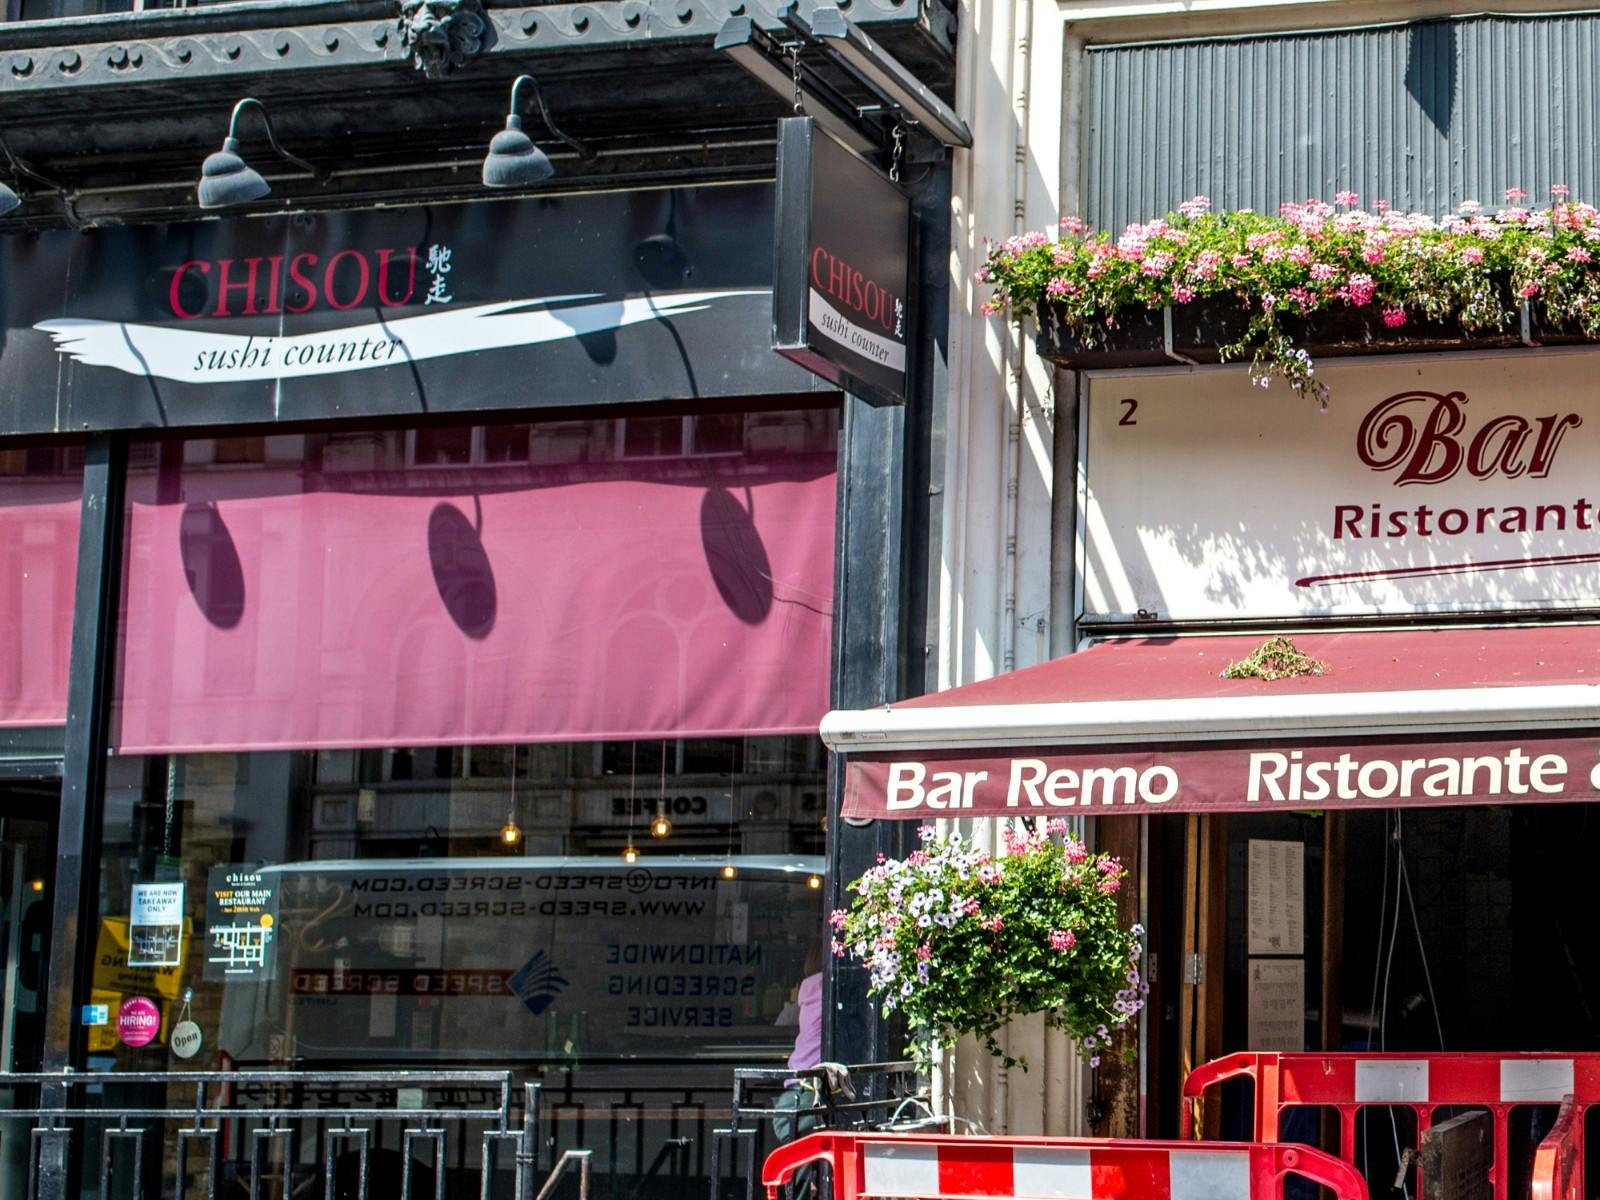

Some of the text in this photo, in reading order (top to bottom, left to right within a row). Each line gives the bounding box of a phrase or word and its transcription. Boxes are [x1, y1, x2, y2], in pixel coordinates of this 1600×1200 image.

[169, 247, 417, 320] CHISOU
[812, 247, 893, 330] CHISOU
[193, 336, 403, 371] sushi counter
[822, 311, 890, 362] sushi counter
[1118, 398, 1138, 426] 2
[1356, 390, 1583, 488] Bar
[886, 761, 988, 811] Bar
[1006, 758, 1179, 808] Remo
[1247, 748, 1568, 802] Ristorante
[215, 890, 272, 898] VISIT OUR MAIN
[226, 873, 261, 882] chisou
[120, 1016, 156, 1025] HIRING!
[174, 1033, 198, 1047] Open
